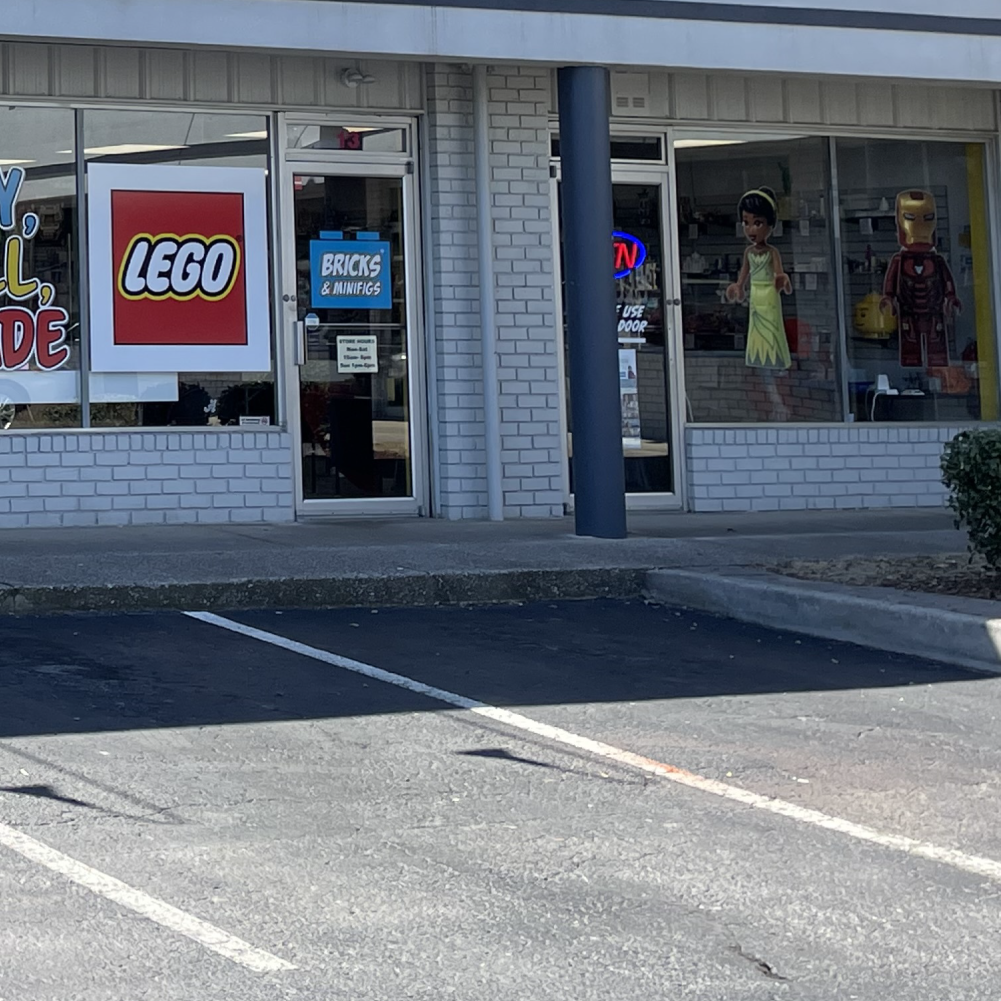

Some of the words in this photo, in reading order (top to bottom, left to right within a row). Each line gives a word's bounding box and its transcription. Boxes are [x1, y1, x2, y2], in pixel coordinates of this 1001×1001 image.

[118, 233, 241, 301] LEGO
[321, 253, 381, 277] BRICKS
[321, 281, 330, 295] &
[333, 281, 381, 296] MINIFIGS
[622, 305, 645, 318] USE
[617, 320, 648, 333] DOOR
